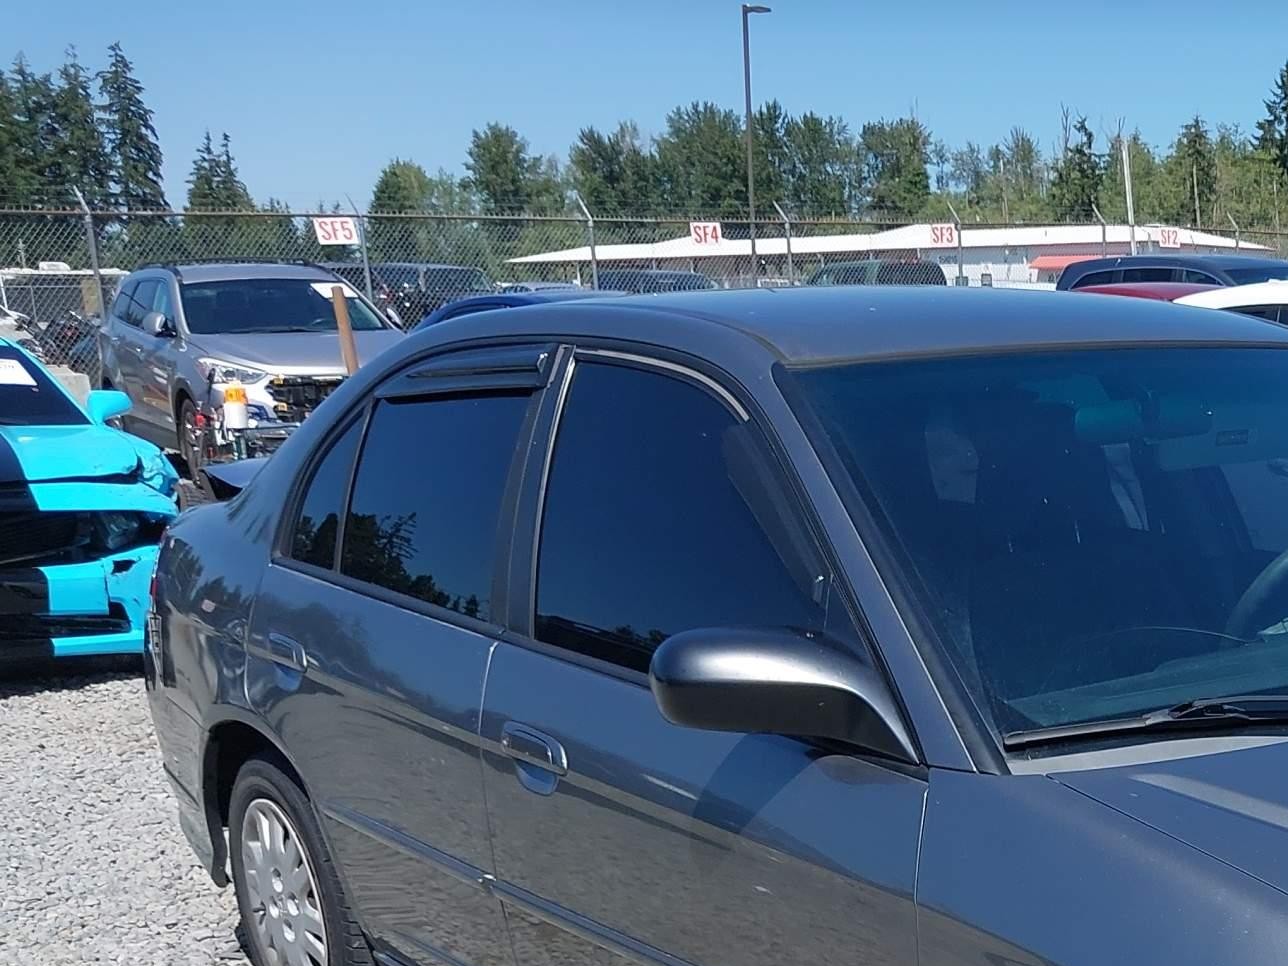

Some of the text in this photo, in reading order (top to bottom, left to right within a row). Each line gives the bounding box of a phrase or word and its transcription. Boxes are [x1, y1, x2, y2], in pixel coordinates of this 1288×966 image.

[319, 220, 354, 241] SF5
[693, 225, 719, 244] SF4
[932, 226, 954, 243] SF3
[1160, 229, 1179, 246] SF2
